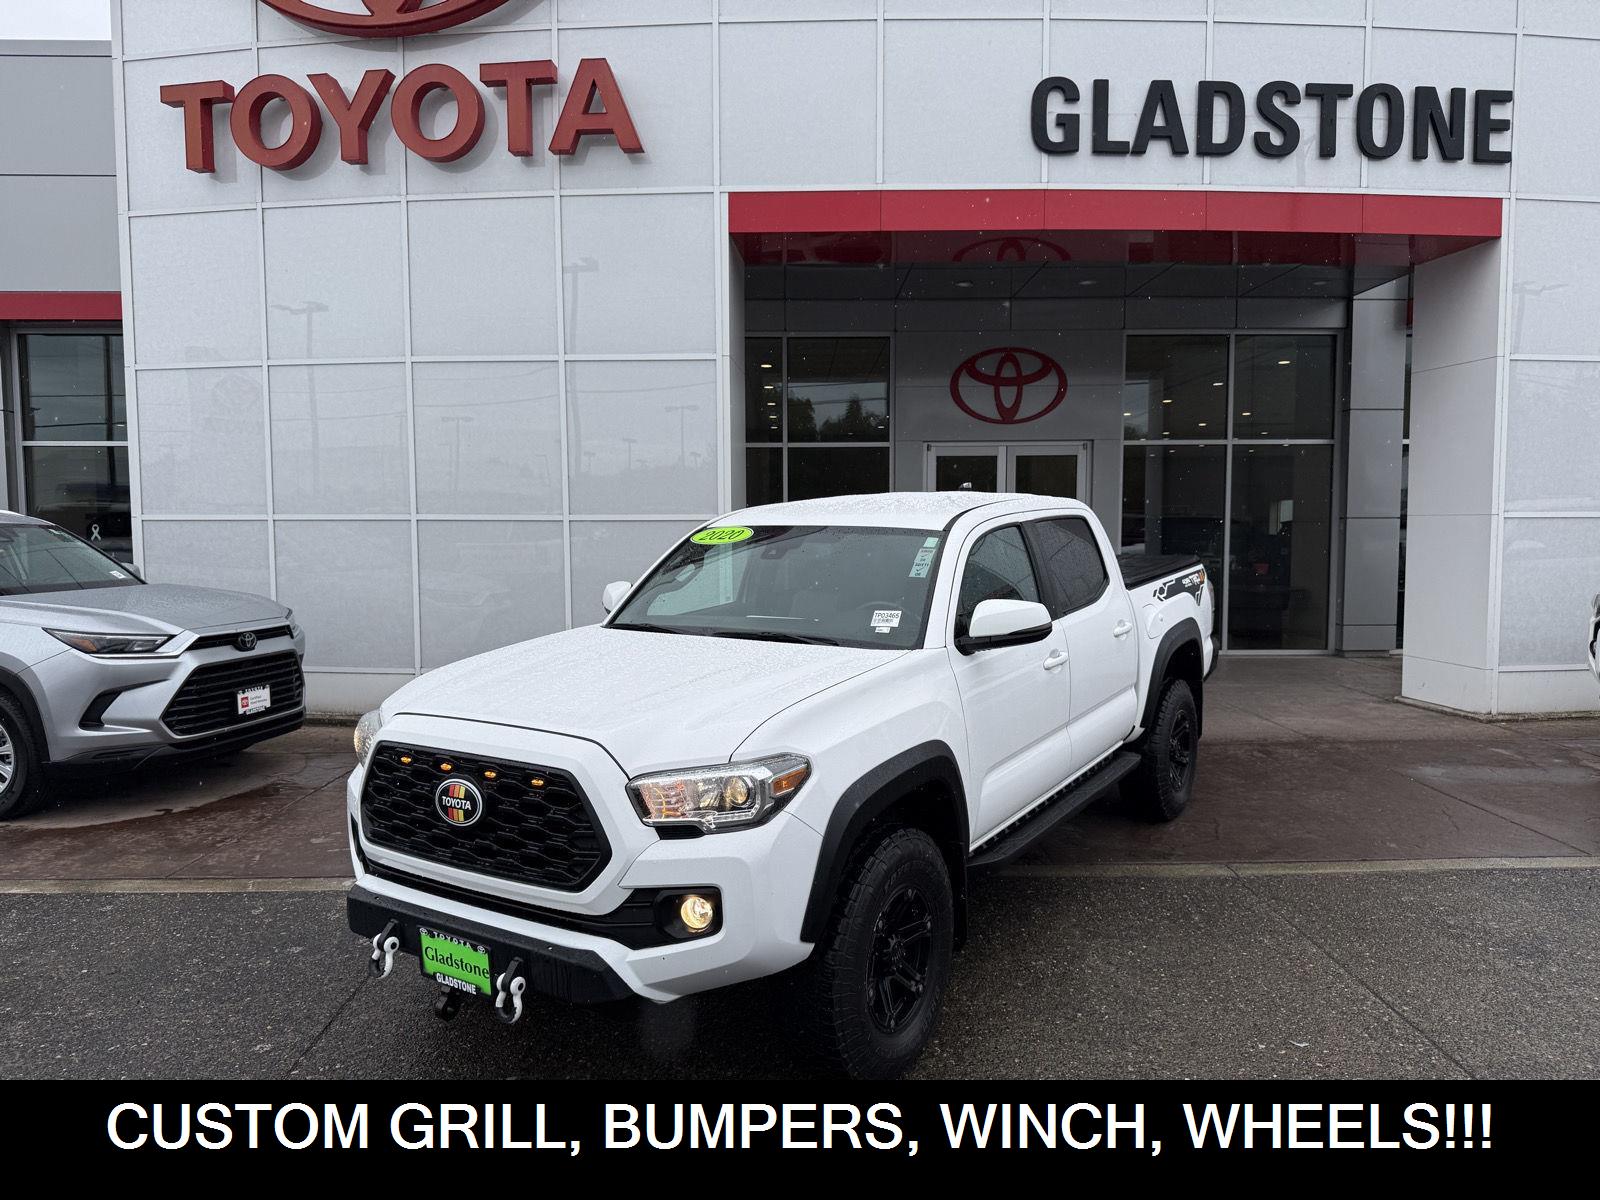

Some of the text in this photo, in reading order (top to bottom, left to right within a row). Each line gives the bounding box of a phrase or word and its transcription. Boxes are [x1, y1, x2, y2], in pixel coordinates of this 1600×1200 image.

[160, 57, 646, 174] TOYOTA
[1031, 76, 1514, 164] GLADSTONE
[698, 529, 745, 541] 2020
[441, 796, 472, 811] TOYOTA
[432, 931, 472, 949] TOYOTA
[424, 946, 490, 979] Gladstone
[436, 972, 477, 995] GLADSTONE
